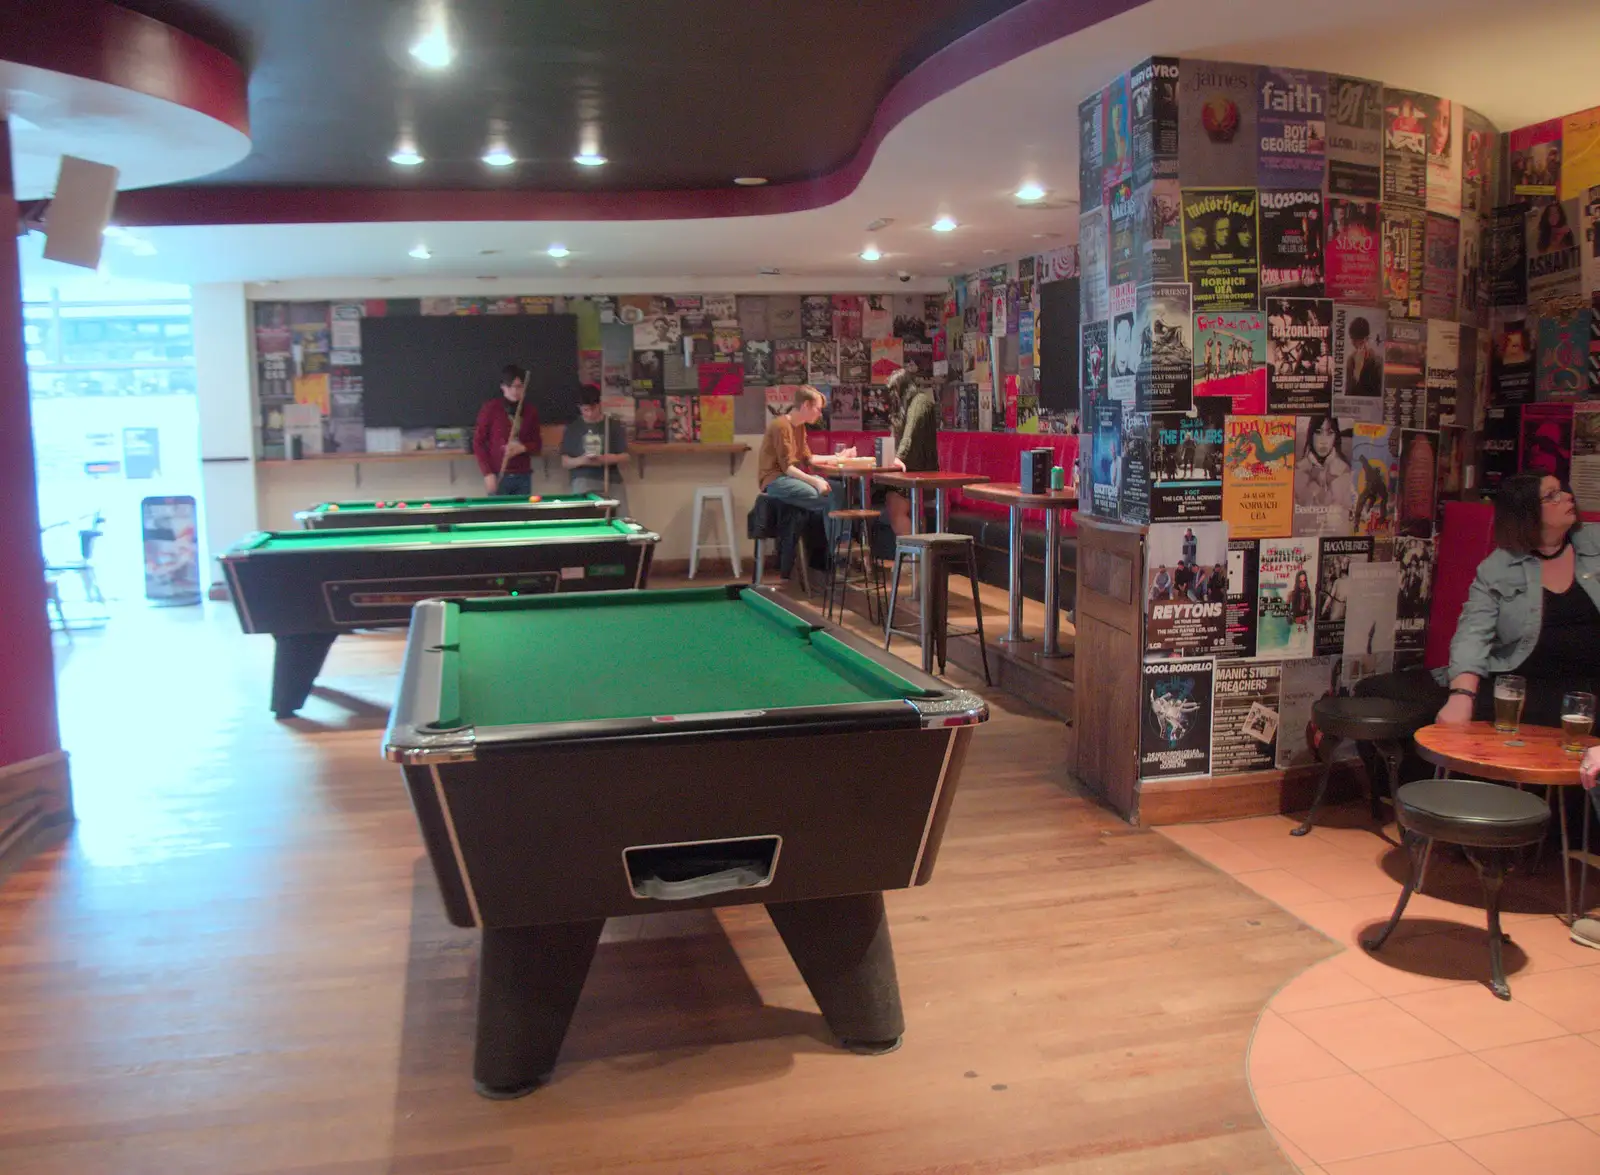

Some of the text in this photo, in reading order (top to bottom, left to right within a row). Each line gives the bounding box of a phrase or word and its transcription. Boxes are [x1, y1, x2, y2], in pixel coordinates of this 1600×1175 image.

[1193, 66, 1248, 91] james
[1261, 81, 1322, 113] faith
[1283, 125, 1307, 138] BOY
[1261, 137, 1307, 153] GEORGE
[1186, 194, 1255, 219] Motörhead
[1260, 192, 1320, 209] BLOSSOMS
[1201, 276, 1246, 287] NORWICH
[1215, 286, 1232, 294] UEA
[1272, 325, 1329, 338] RAZORLIGHT
[1334, 309, 1346, 394] TOM GRENNAN
[1229, 420, 1292, 437] TRIVIUM
[1159, 429, 1178, 444] THE
[1239, 500, 1278, 510] NORWICH
[1250, 511, 1266, 520] UEA
[1152, 602, 1223, 620] REYTONS
[1143, 662, 1212, 674] OGOL BORDELLO
[1216, 667, 1247, 680] MANIC
[1215, 679, 1267, 692] PREACHERS
